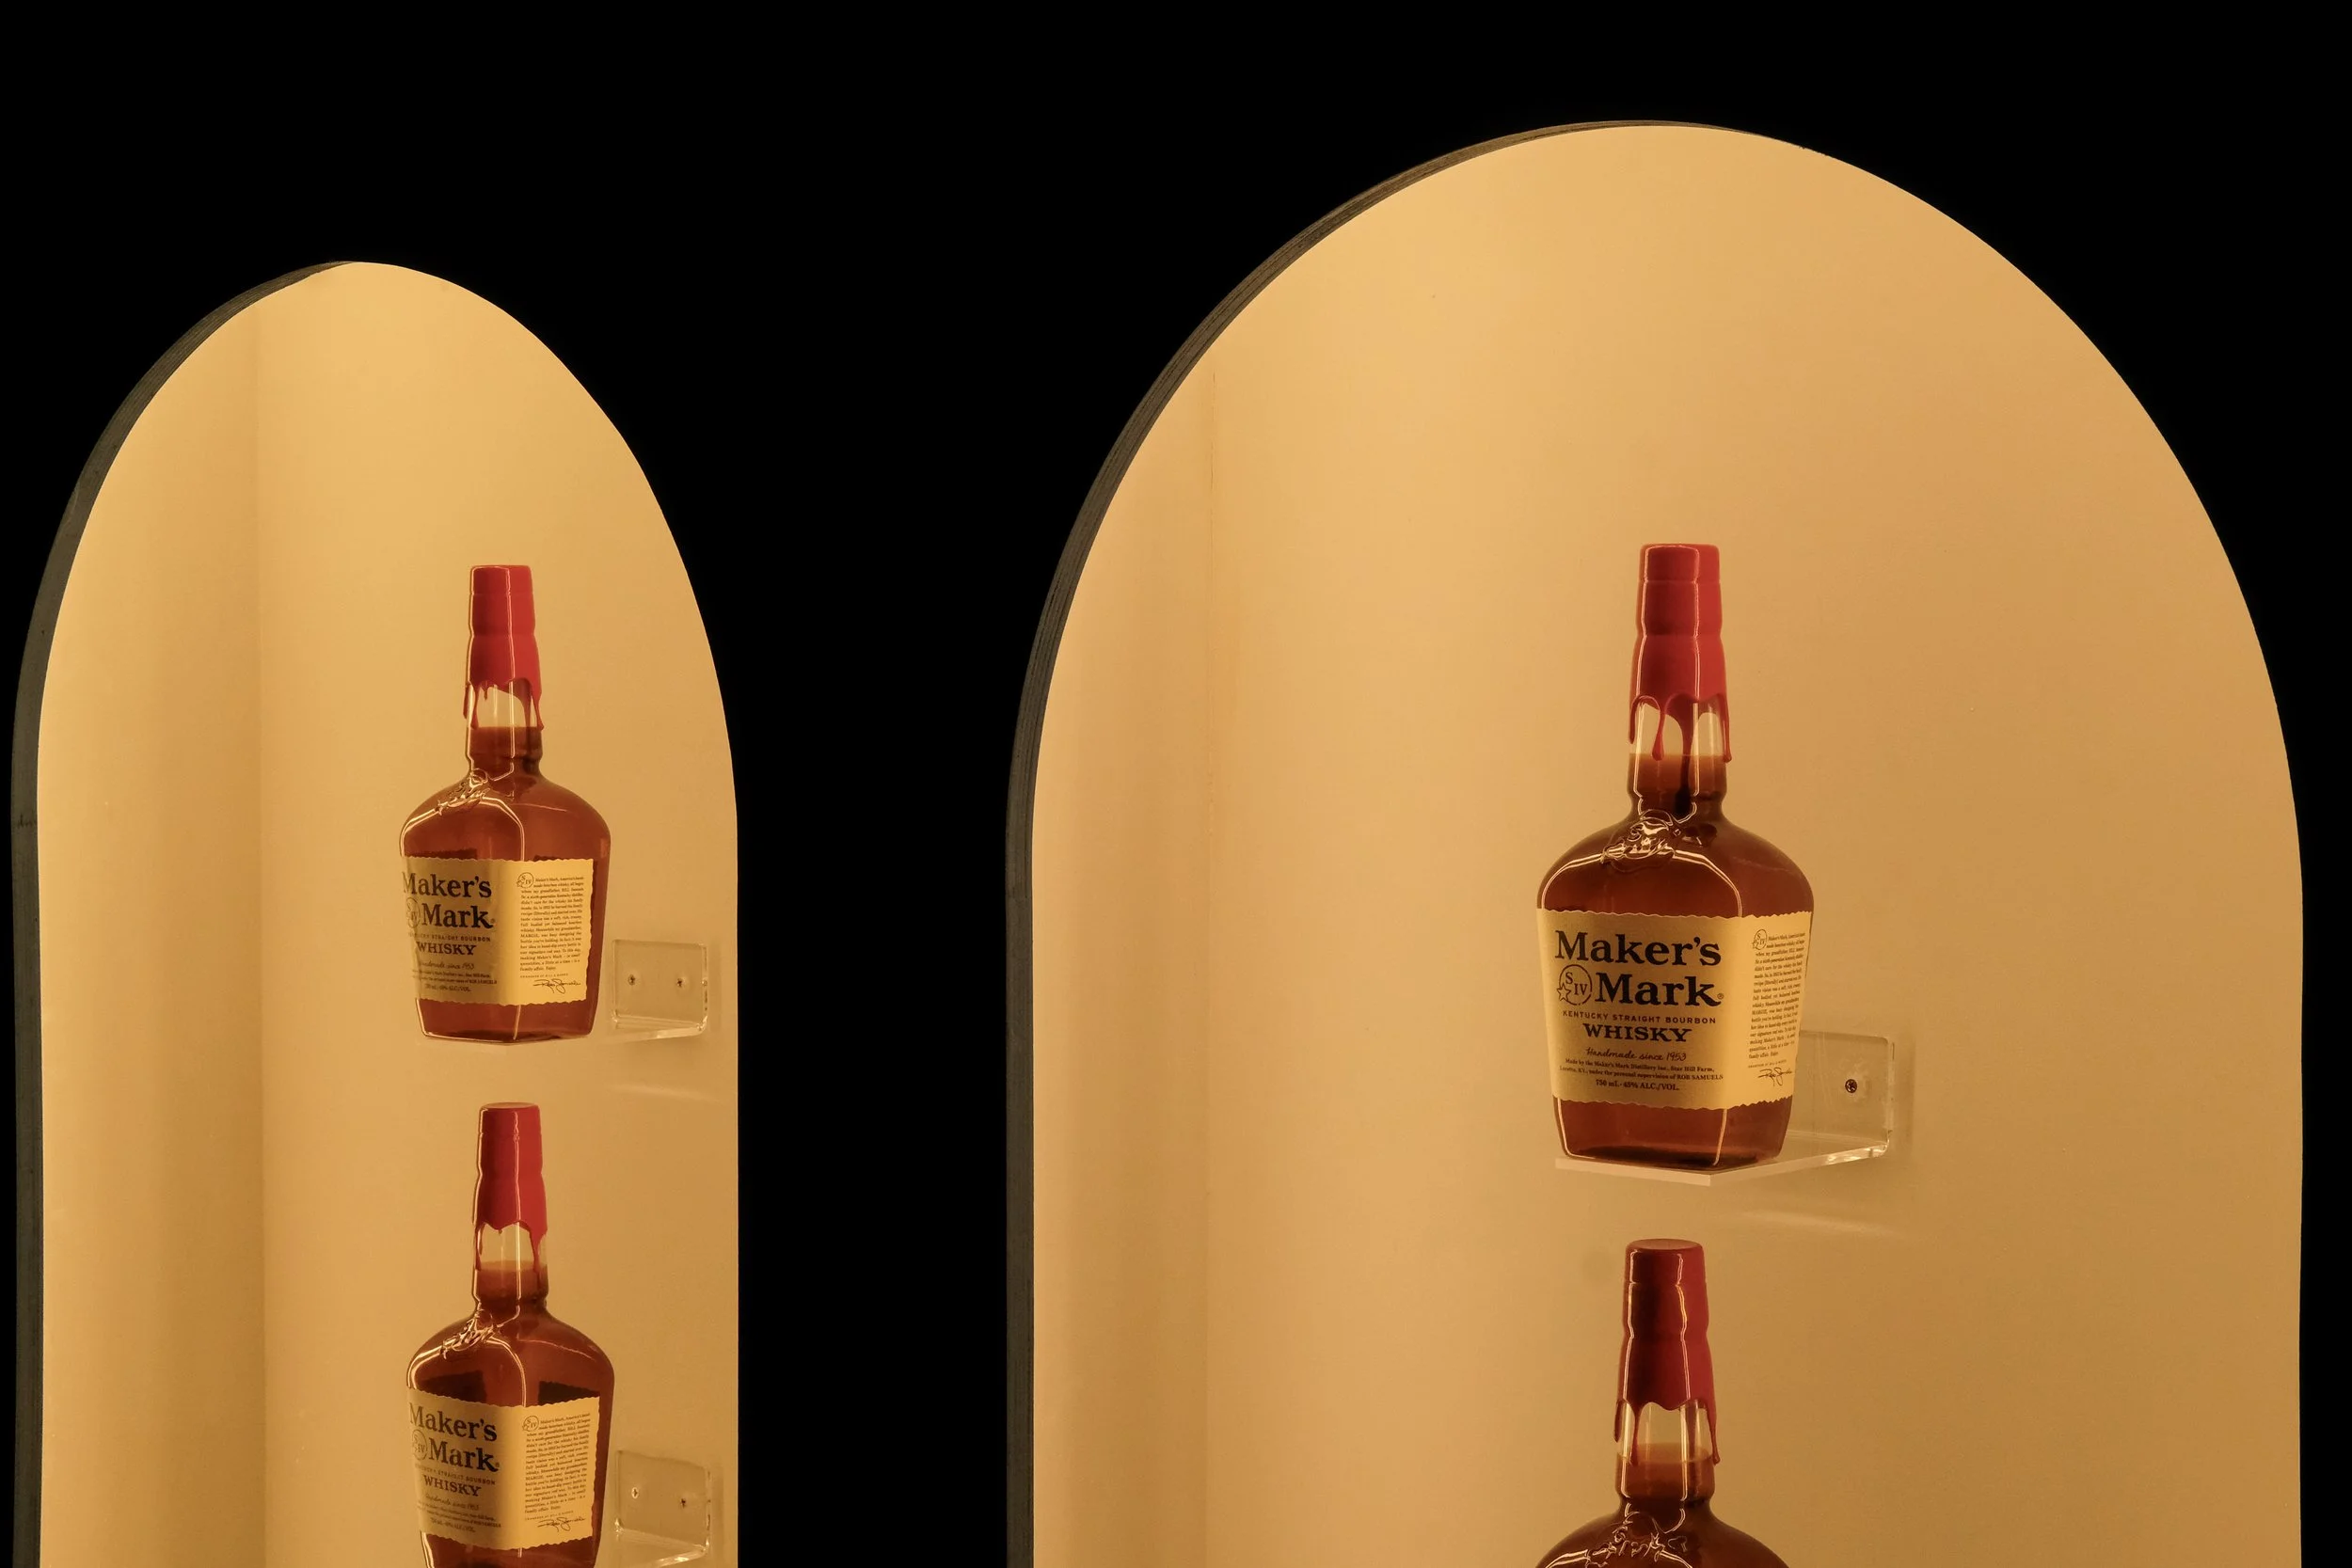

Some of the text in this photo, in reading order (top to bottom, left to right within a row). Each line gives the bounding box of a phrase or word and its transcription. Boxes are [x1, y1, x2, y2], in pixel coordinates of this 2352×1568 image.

[402, 872, 493, 898] Maker's
[416, 941, 477, 956] WHISKY
[1555, 930, 1722, 966] Maker's
[1565, 971, 1590, 996] S IV
[1562, 1010, 1716, 1025] KENTUCKY STRAIGHT BOURBON
[1582, 1022, 1693, 1043] WHISKY
[1585, 1046, 1687, 1062] Handmade since 1953
[409, 1402, 498, 1442] Maker's
[422, 1473, 482, 1497] WHISKY
